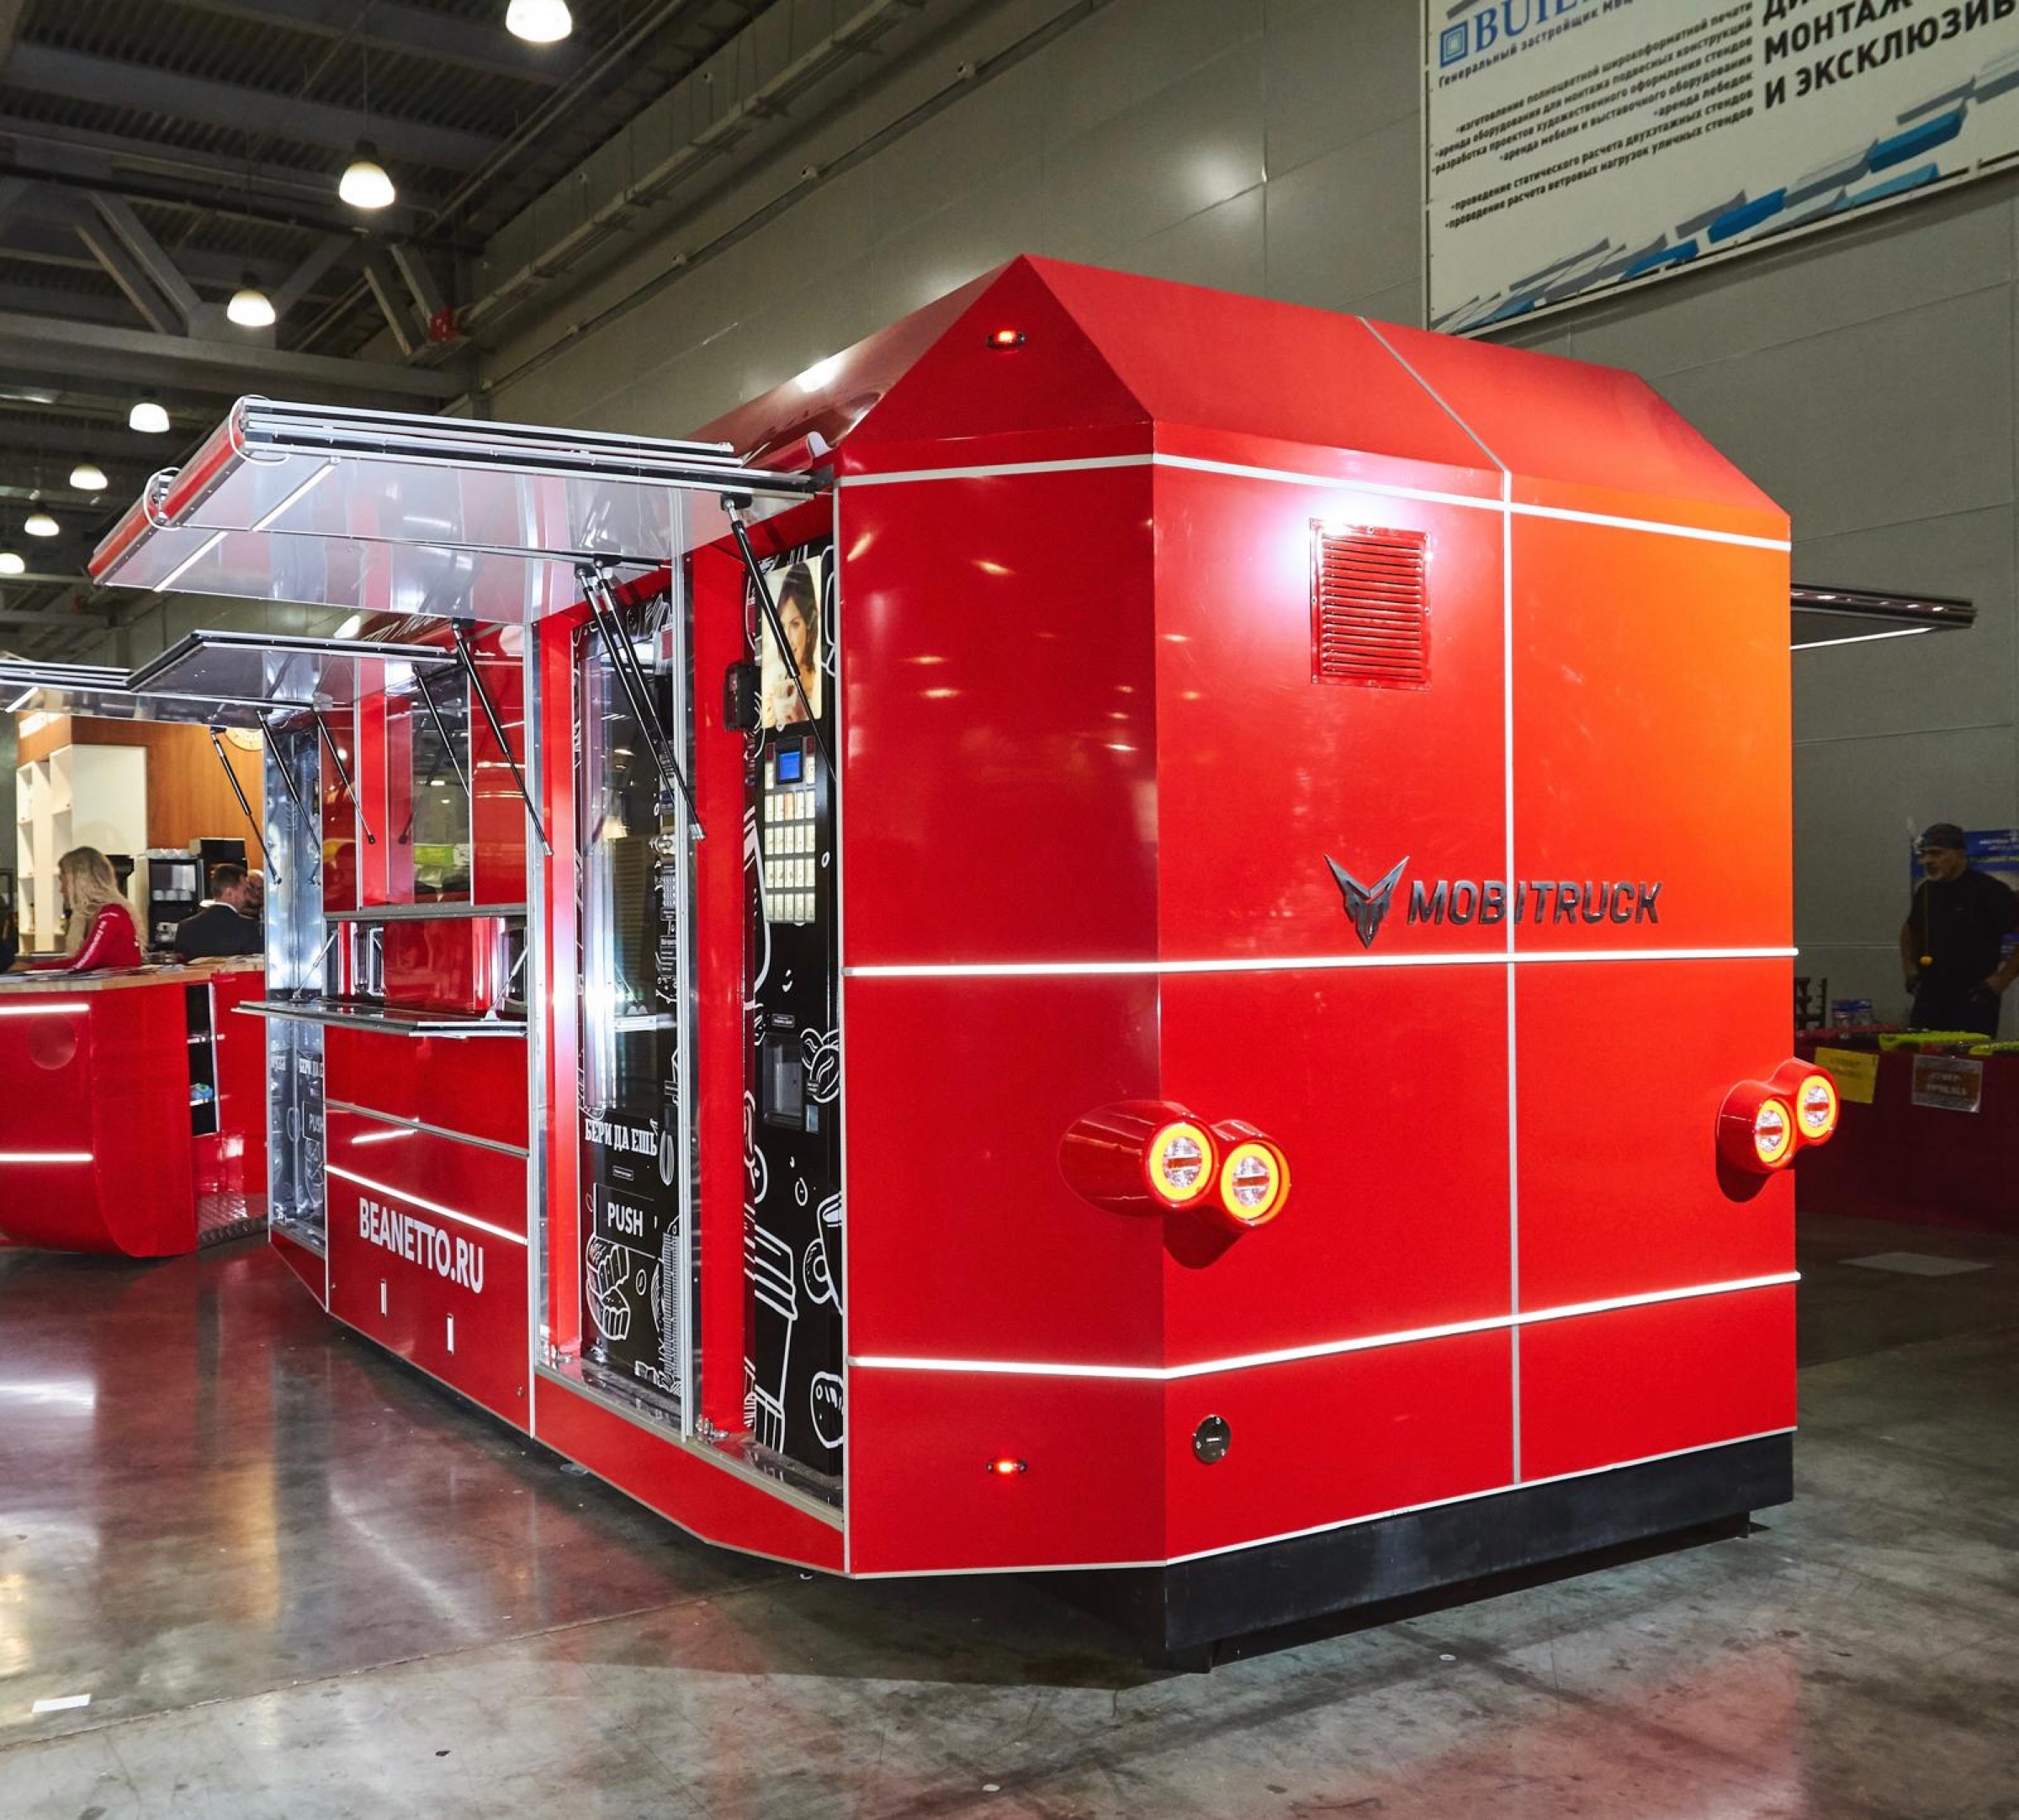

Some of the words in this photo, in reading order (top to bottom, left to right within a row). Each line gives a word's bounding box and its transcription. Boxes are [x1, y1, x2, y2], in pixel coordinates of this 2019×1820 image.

[1439, 43, 1517, 88] Генеральный
[1521, 8, 1598, 51] застройщик
[1603, 19, 1708, 72] широкоформатной
[1711, 1, 1752, 26] печати
[1435, 145, 1487, 175] разработка
[1489, 126, 1534, 151] проектов
[1537, 88, 1628, 132] художественного
[1630, 58, 1702, 93] оформления
[1704, 36, 1752, 63] стендов
[1439, 136, 1471, 156] аренда
[1543, 99, 1562, 115] для
[1564, 79, 1610, 104] монтажа
[1613, 52, 1674, 85] подвесных
[1677, 17, 1752, 58] конструкций
[1504, 140, 1539, 161] аренда
[1541, 124, 1579, 145] мебели
[1582, 121, 1588, 130] и
[1591, 89, 1667, 126] выставочного
[1669, 54, 1752, 95] оборудования
[1658, 93, 1699, 117] аренда
[1765, 76, 1785, 109] И
[1449, 200, 1505, 230] проведение
[1508, 185, 1546, 208] расчета
[1548, 165, 1598, 191] ветровых
[1601, 146, 1649, 171] нагрузок
[1652, 125, 1704, 155] уличных
[1705, 106, 1754, 132] стендов
[1455, 182, 1512, 211] проведение
[1513, 156, 1580, 188] статического
[1582, 139, 1624, 167] расчета
[1625, 108, 1703, 148] двухэтажных
[1705, 88, 1753, 115] стендов
[1408, 880, 1662, 926] MOBITRUCK
[585, 1119, 612, 1146] БЕРИ
[614, 1124, 629, 1151] ДА
[631, 1128, 658, 1156] ЕШЬ
[359, 1197, 484, 1294] BEANETTO.RU
[607, 1202, 643, 1237] PUSH
